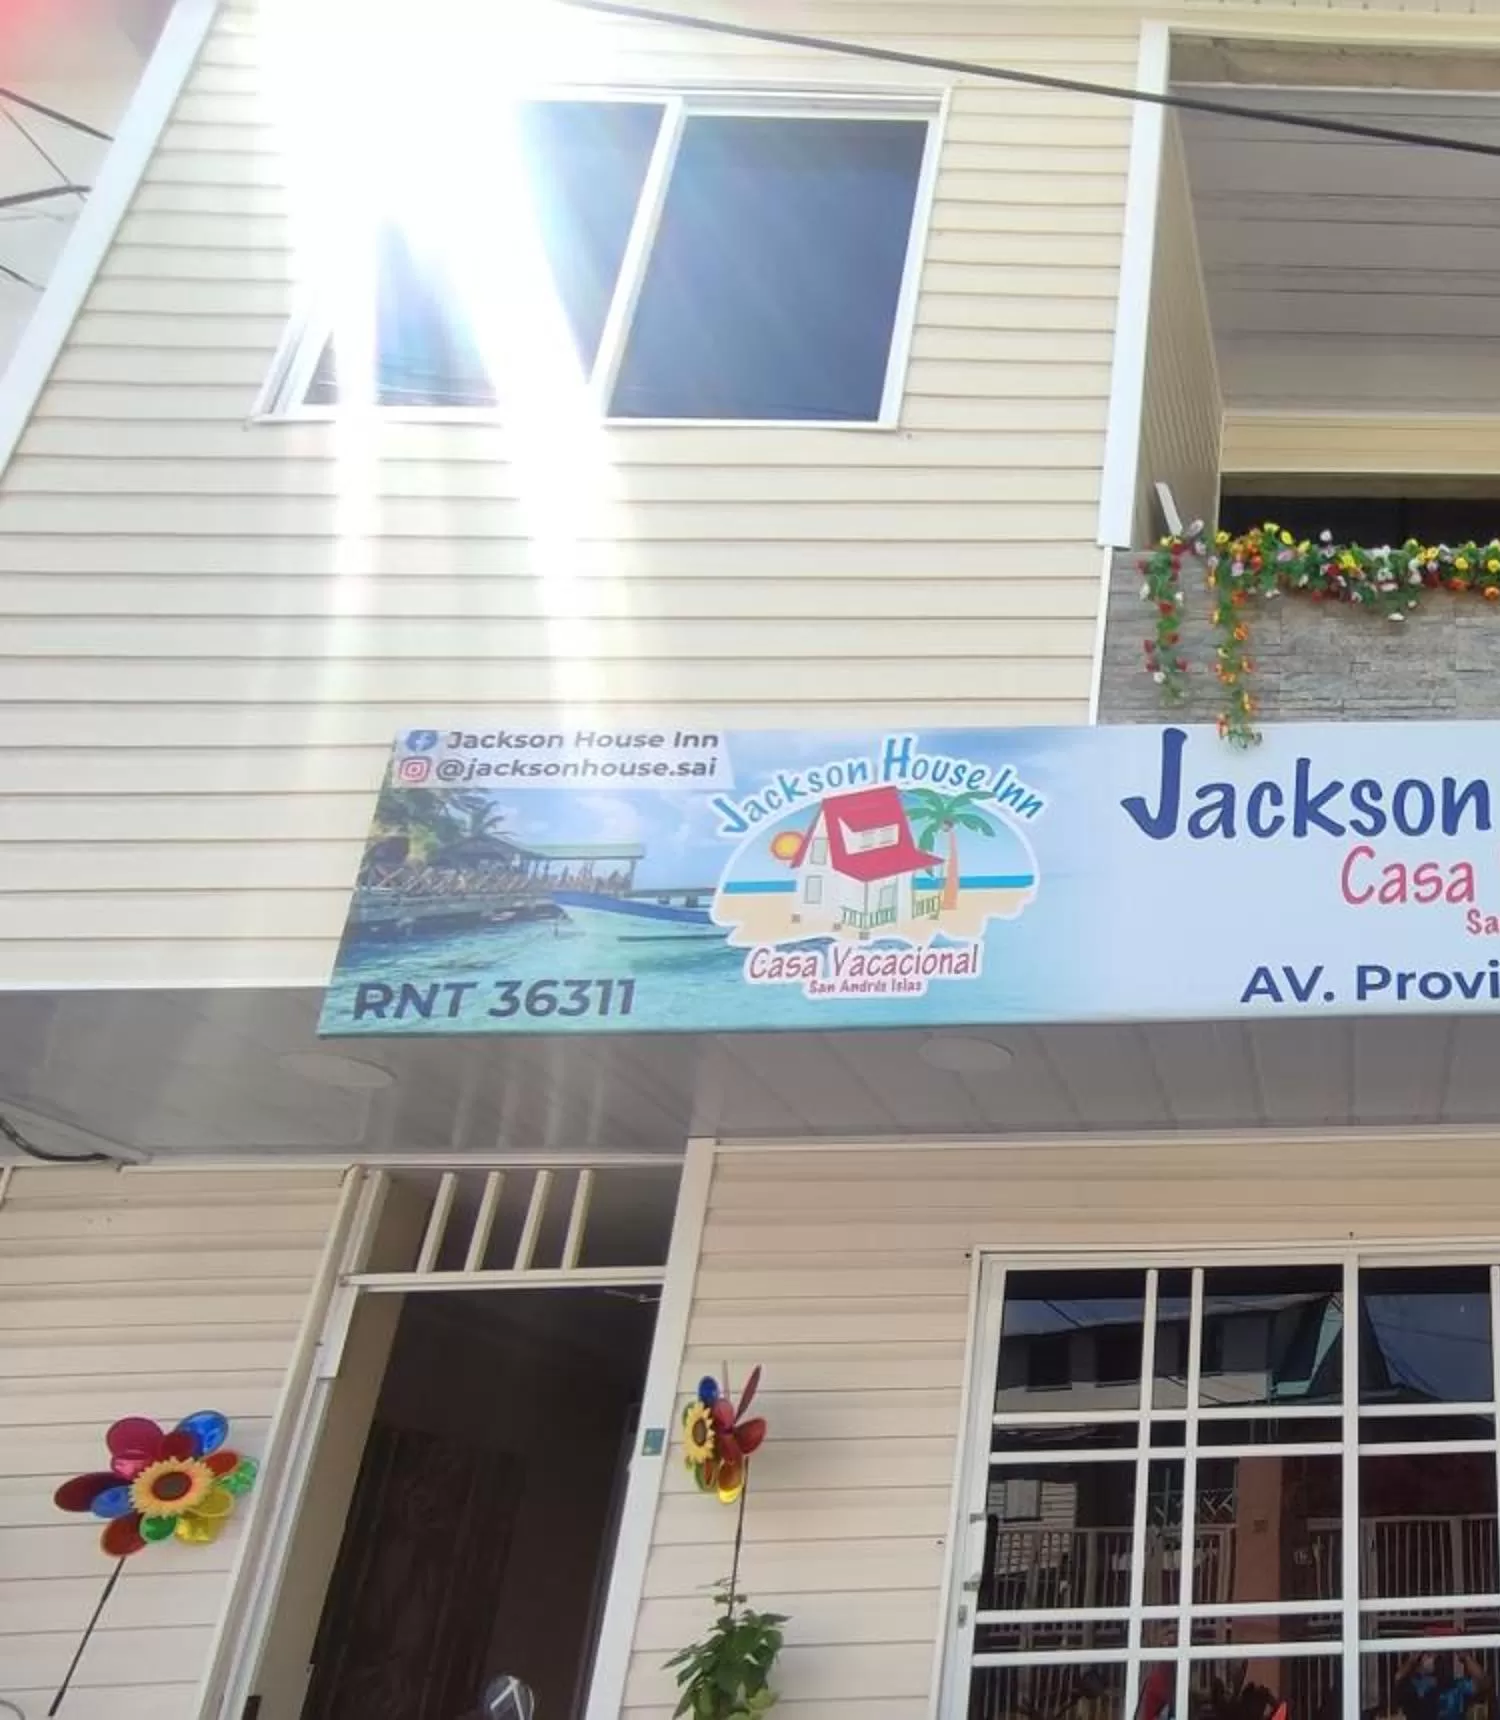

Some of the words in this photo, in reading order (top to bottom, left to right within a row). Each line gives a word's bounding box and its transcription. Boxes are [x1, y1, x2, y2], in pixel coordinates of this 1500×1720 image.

[448, 731, 563, 750] Jackson
[575, 731, 664, 749] House
[674, 731, 718, 748] Inn
[436, 757, 717, 781] @jacksonhouse.sai
[712, 761, 867, 834] Jackson
[883, 737, 985, 790] House
[993, 768, 1044, 819] Inn
[1121, 727, 1492, 840] Jackson
[1341, 845, 1475, 904] Casa
[750, 948, 817, 978] Casa
[832, 944, 978, 976] Vacacional
[352, 982, 480, 1020] RNT
[488, 979, 636, 1017] 36311
[809, 979, 835, 994] San
[892, 978, 921, 992] Islas
[1240, 965, 1336, 1003] AV.
